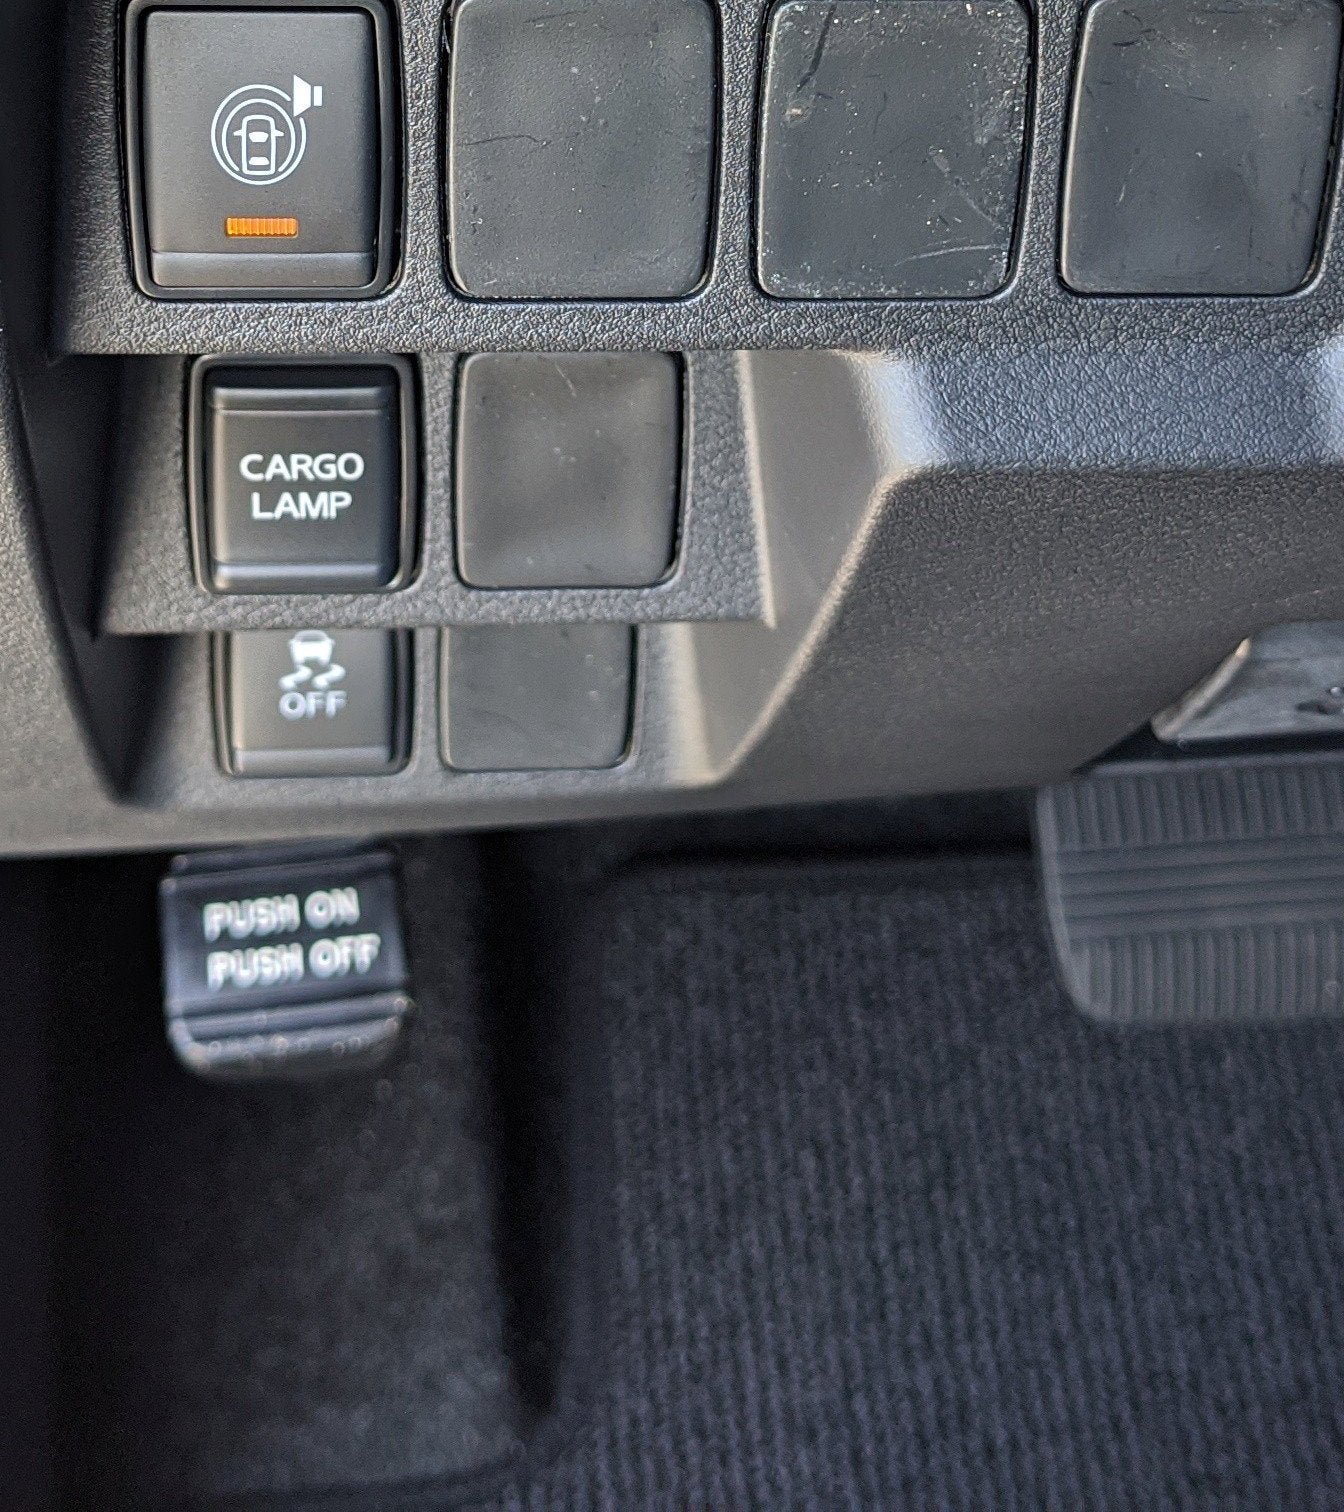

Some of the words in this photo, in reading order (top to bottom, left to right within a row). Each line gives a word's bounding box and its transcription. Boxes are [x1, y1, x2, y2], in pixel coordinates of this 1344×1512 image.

[239, 452, 365, 482] CARGO
[250, 490, 353, 521] LAMP
[278, 691, 347, 719] OFF
[203, 893, 301, 941] PUSH
[305, 886, 359, 930] ON
[207, 941, 305, 990] PUSH
[308, 933, 382, 978] OFF
